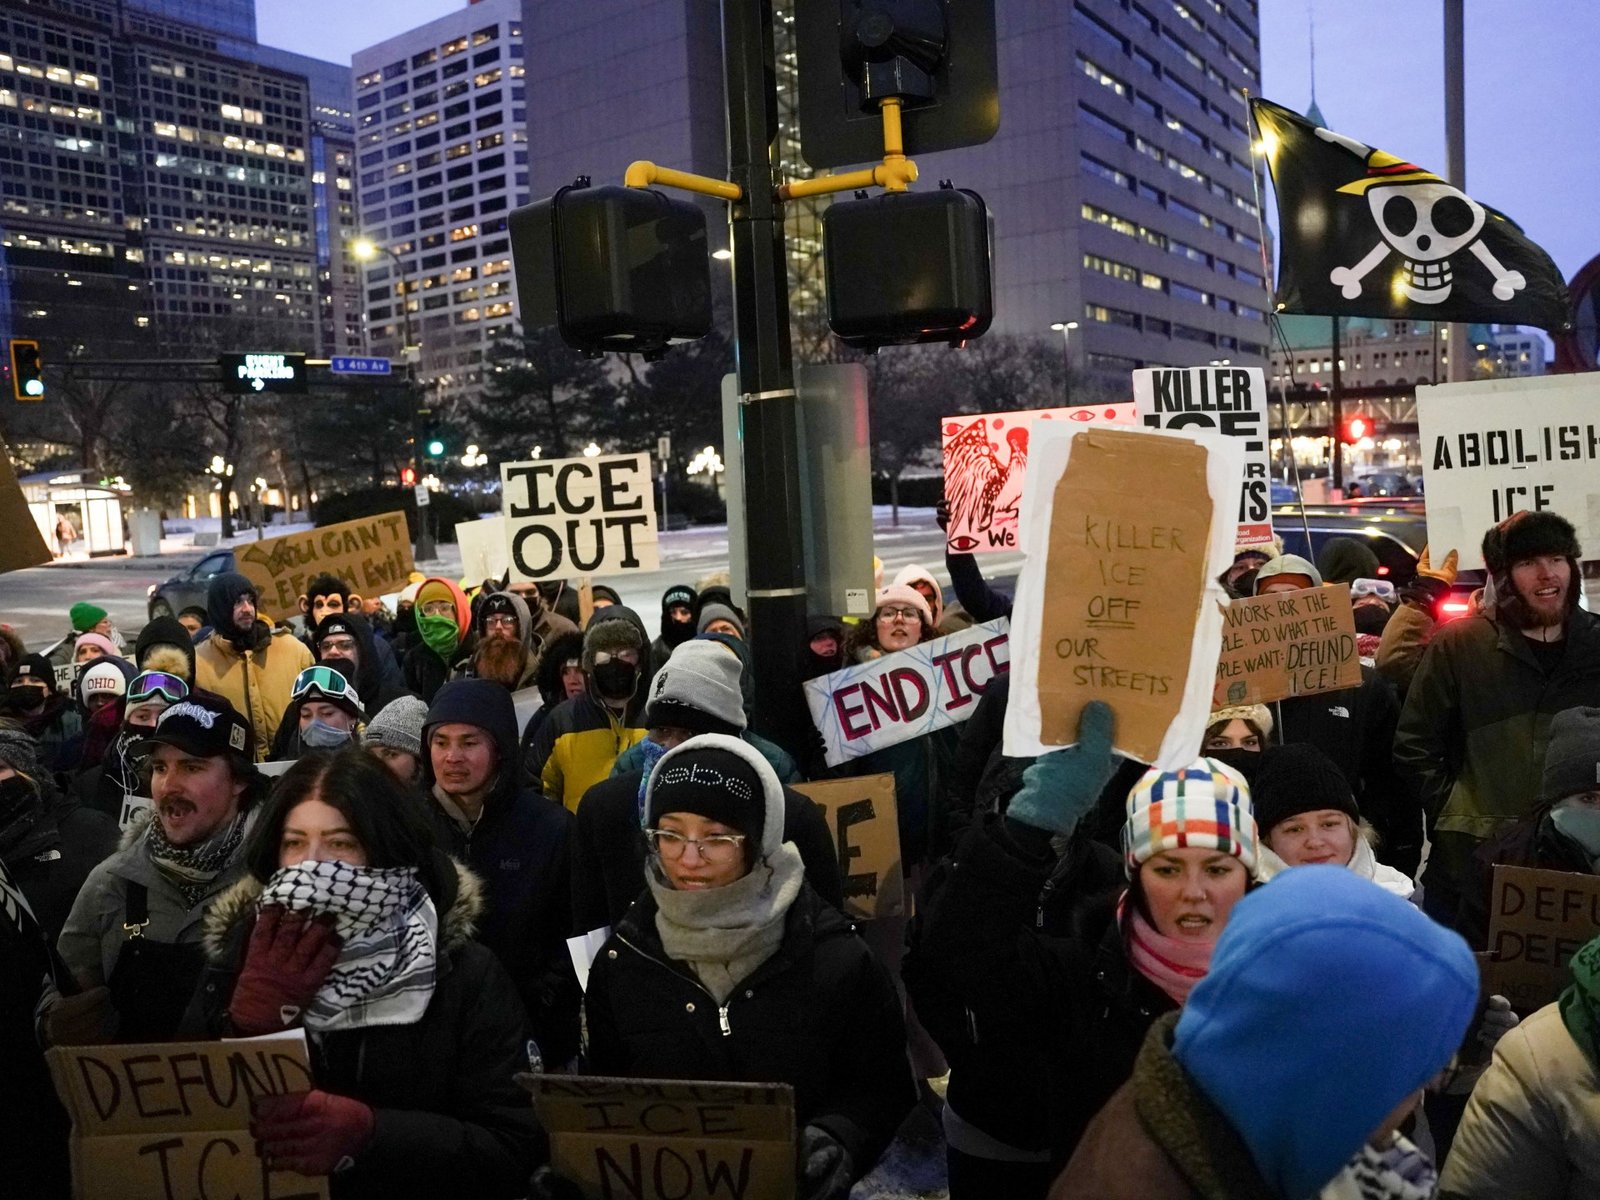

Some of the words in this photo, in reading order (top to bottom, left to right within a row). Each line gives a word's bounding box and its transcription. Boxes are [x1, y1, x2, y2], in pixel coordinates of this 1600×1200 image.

[338, 360, 345, 370] S
[349, 360, 367, 370] 4th
[371, 361, 384, 371] Av
[1152, 369, 1252, 412] KILLER
[507, 458, 642, 518] ICE
[512, 515, 648, 578] OUT
[988, 527, 1016, 547] We
[1085, 515, 1186, 553] KILLER
[1099, 559, 1146, 586] ICE
[1088, 595, 1141, 619] OFF
[1224, 604, 1275, 628] WORK
[1277, 599, 1300, 617] FOR
[1302, 592, 1331, 613] THE
[1251, 628, 1271, 645] DO
[1273, 619, 1309, 642] WHAT
[1312, 616, 1338, 633] THE
[1056, 638, 1107, 660] OUR
[1287, 634, 1354, 670] DEFUND
[87, 677, 116, 690] OHIO
[1073, 664, 1173, 696] STREETS
[1292, 666, 1338, 693] ICE!
[833, 667, 930, 742] END
[77, 1051, 317, 1122] DEFUND
[583, 1102, 745, 1135] ICE
[595, 1142, 752, 1200] NOW
